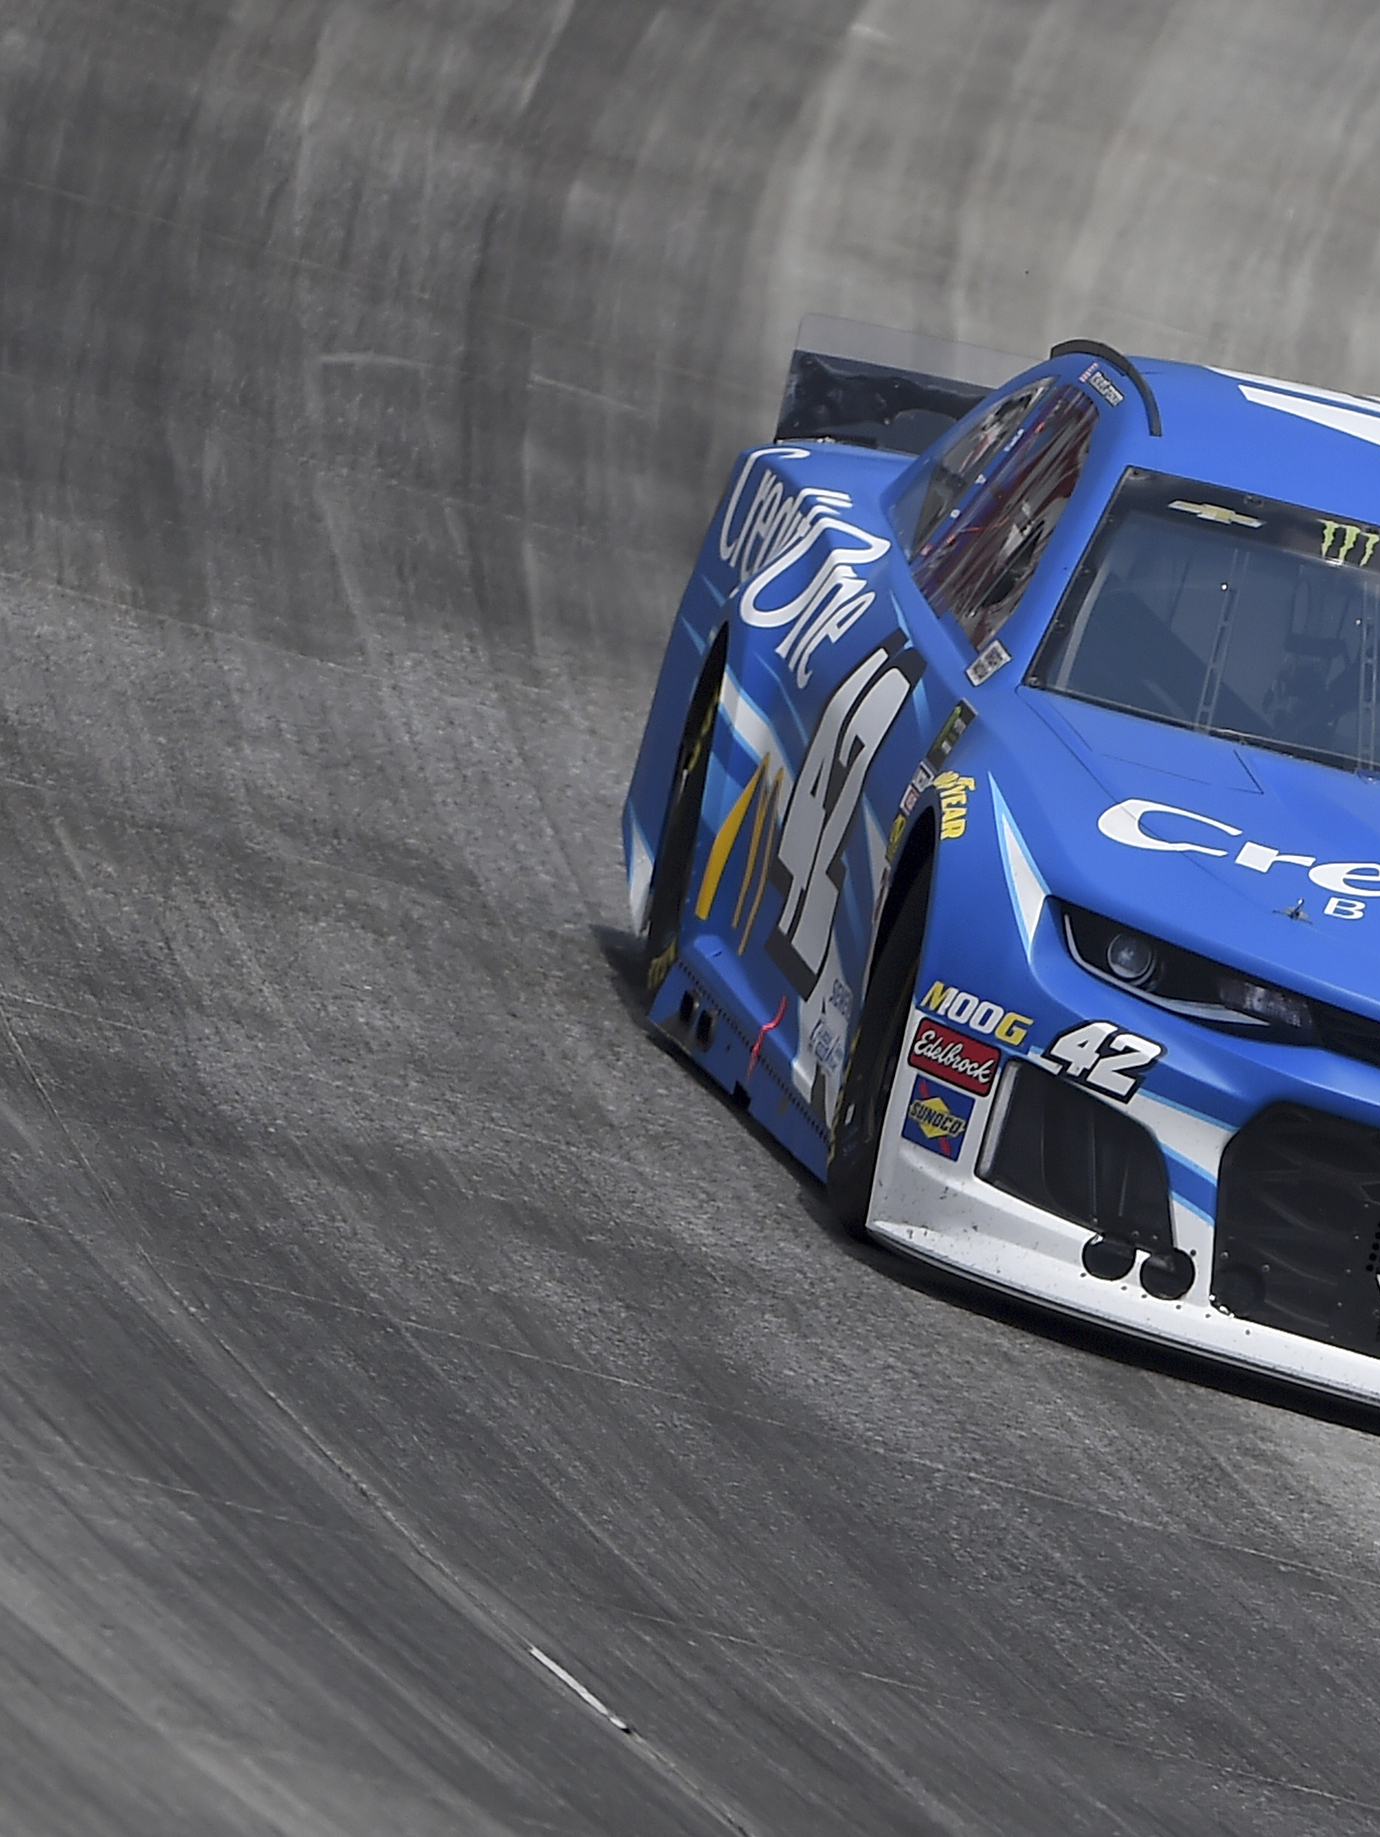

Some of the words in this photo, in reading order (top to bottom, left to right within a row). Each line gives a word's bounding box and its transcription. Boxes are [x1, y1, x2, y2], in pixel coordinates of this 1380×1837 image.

[778, 648, 911, 975] 42
[921, 980, 1034, 1046] MOOG
[913, 1030, 995, 1084] Edelbrock
[1050, 1021, 1162, 1097] 42
[909, 1102, 964, 1135] SUNOCO
